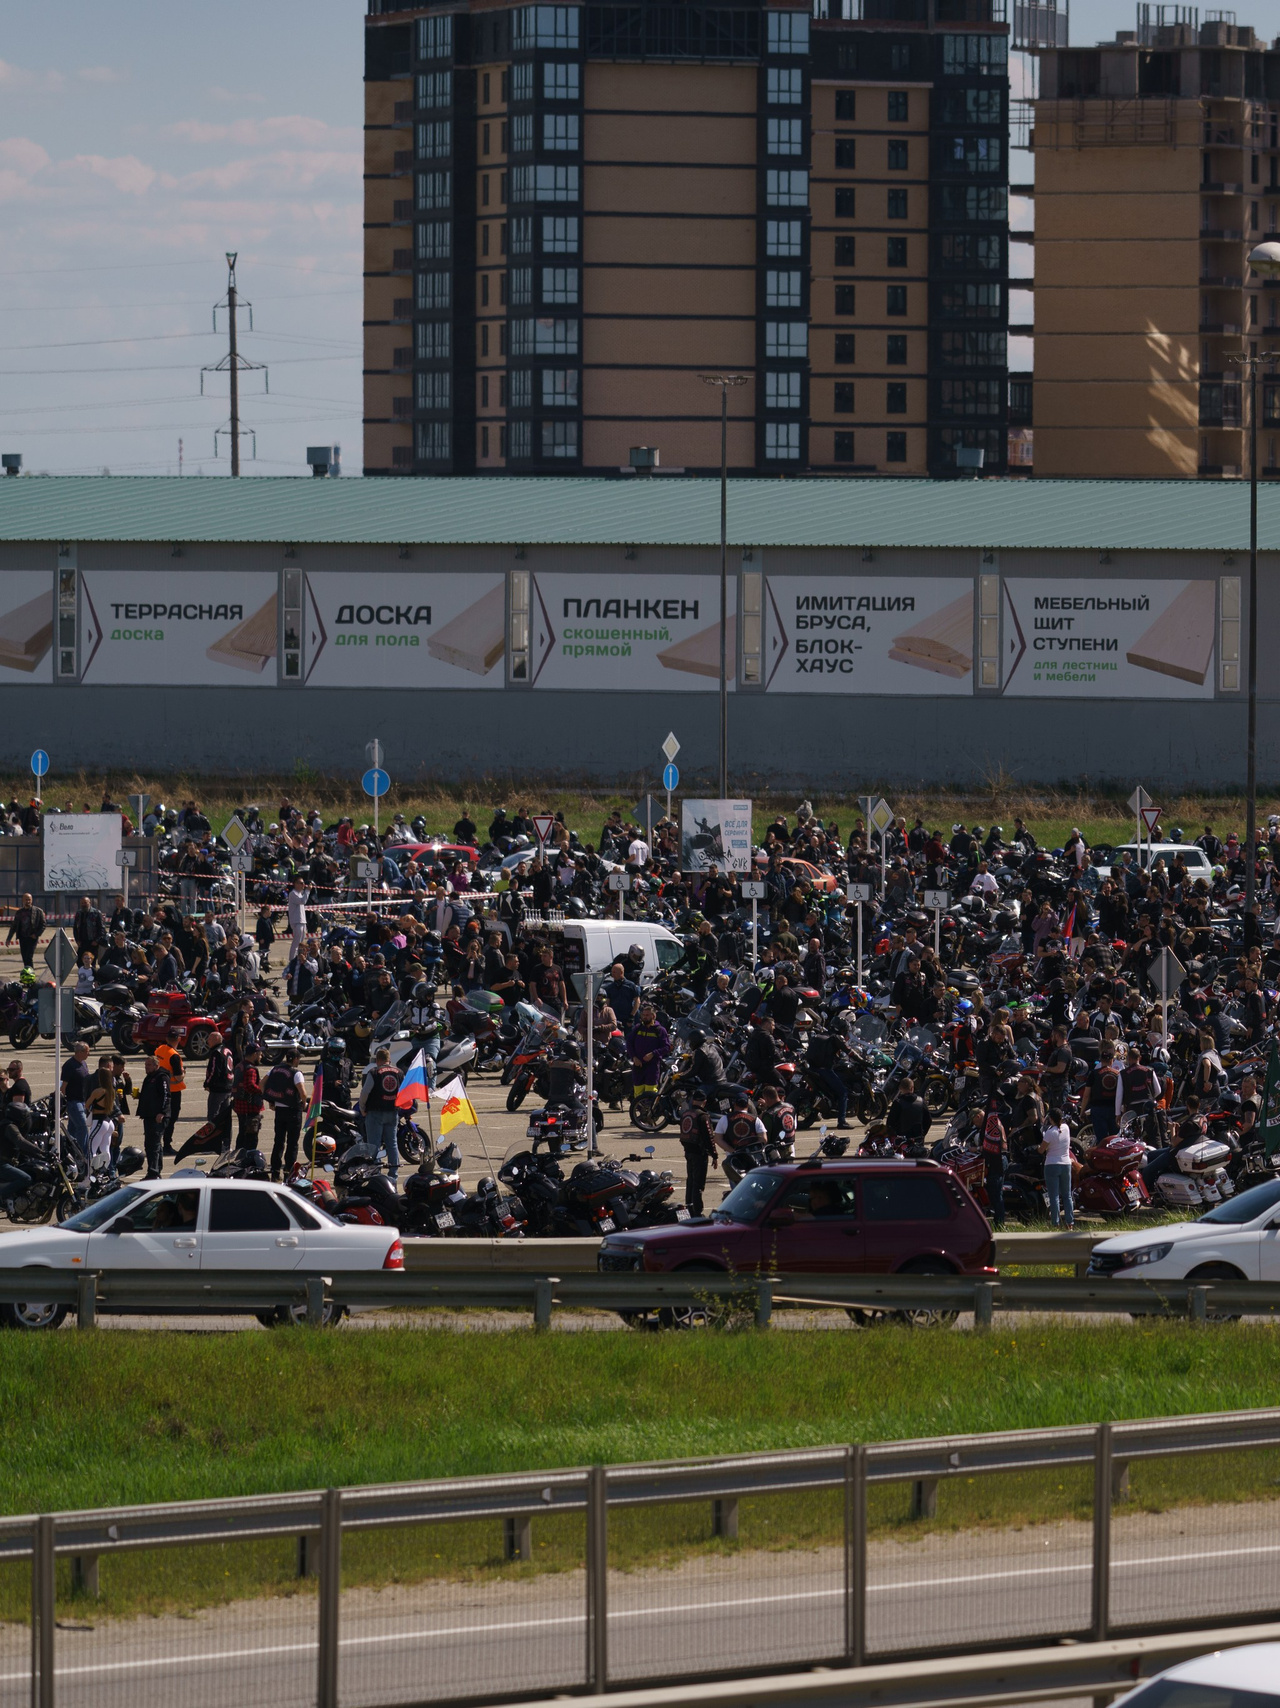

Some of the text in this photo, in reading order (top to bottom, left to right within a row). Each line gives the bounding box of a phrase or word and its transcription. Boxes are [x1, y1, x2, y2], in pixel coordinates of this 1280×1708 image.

[563, 598, 699, 620] ПЛАНКЕН
[796, 596, 915, 612] ИМИТАЦИЯ
[1034, 594, 1150, 611] МЕБЕЛЬНЫЙ
[110, 603, 243, 620] ТЕРРАСНАЯ
[335, 604, 432, 625] ДОСКА
[796, 615, 871, 633] БРУСА,
[1034, 617, 1075, 630] ЩИТ
[110, 628, 165, 641] доска
[335, 634, 420, 647] для пола
[563, 626, 673, 642] скошенный,
[562, 642, 632, 658] прямой
[796, 639, 863, 654] БЛОК-
[1033, 637, 1118, 651] СТУПЕНИ
[796, 658, 854, 674] ХАУС
[1033, 661, 1118, 671] для лестниц
[1033, 671, 1096, 682] и мебели
